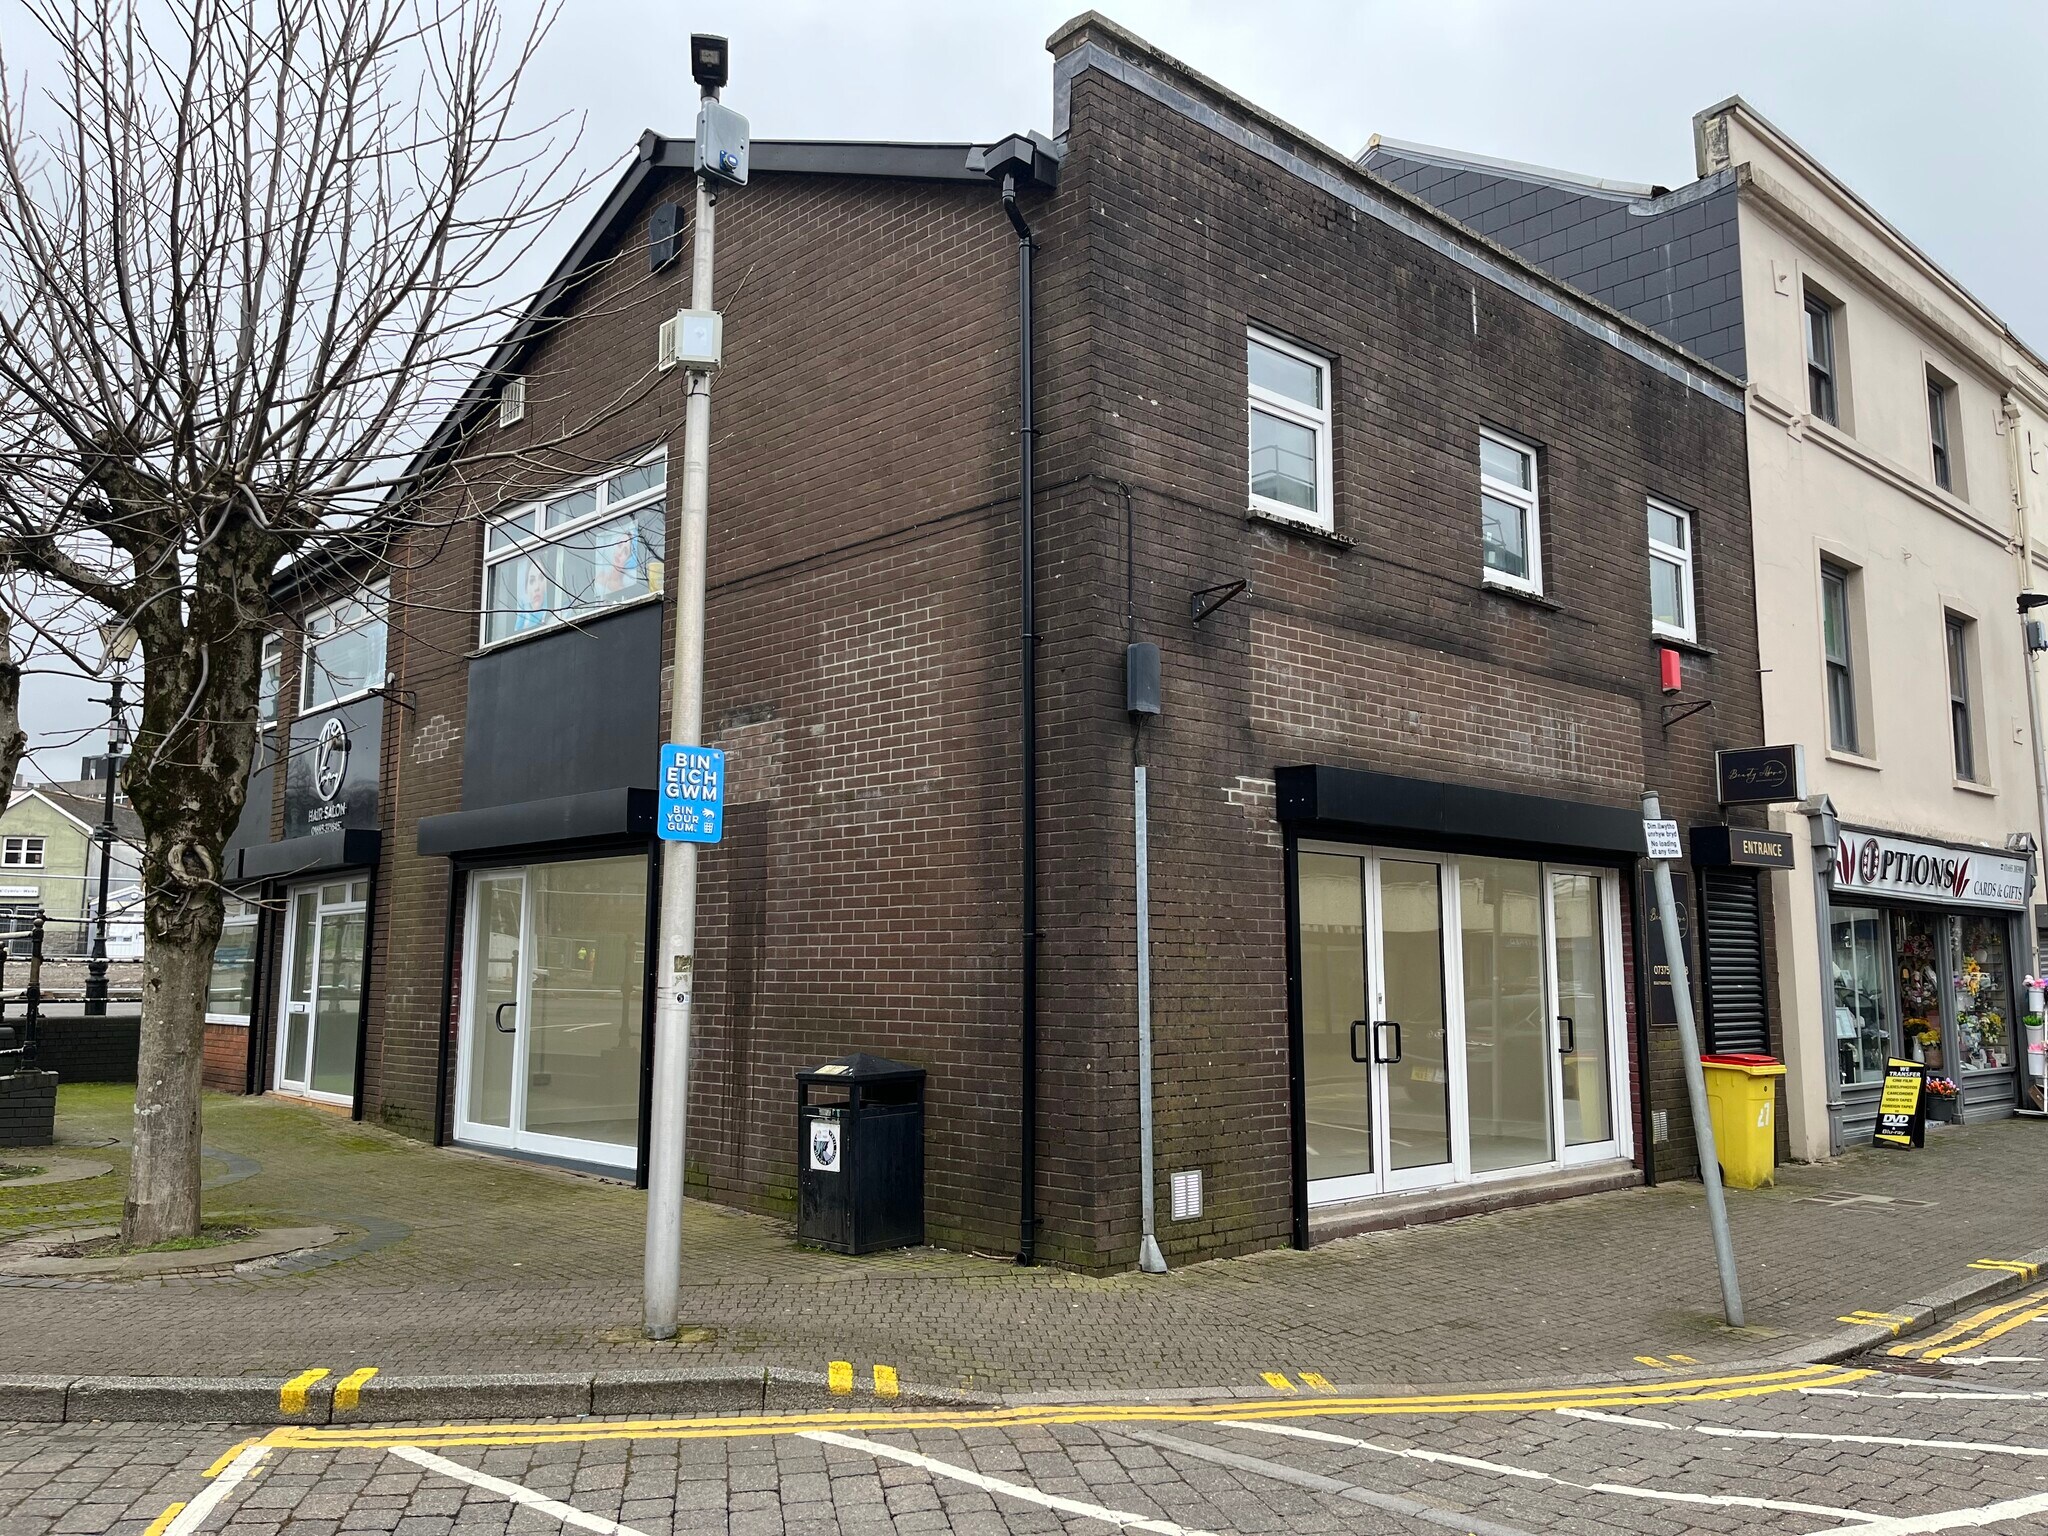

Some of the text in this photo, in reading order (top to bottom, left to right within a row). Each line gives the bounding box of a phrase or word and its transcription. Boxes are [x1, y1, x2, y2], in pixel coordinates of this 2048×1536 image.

[675, 752, 710, 770] BIN
[666, 767, 717, 786] EICH
[665, 783, 717, 802] GWM
[308, 802, 346, 823] HAIR SALON
[666, 813, 699, 824] YOUR
[673, 805, 693, 815] BIN
[667, 822, 697, 832] GUM.
[1743, 840, 1782, 857] ENTRANCE
[1861, 838, 1955, 889] OPTIONS
[1974, 881, 2022, 901] CARDS & GIFTS
[1884, 1114, 1908, 1122] DVD
